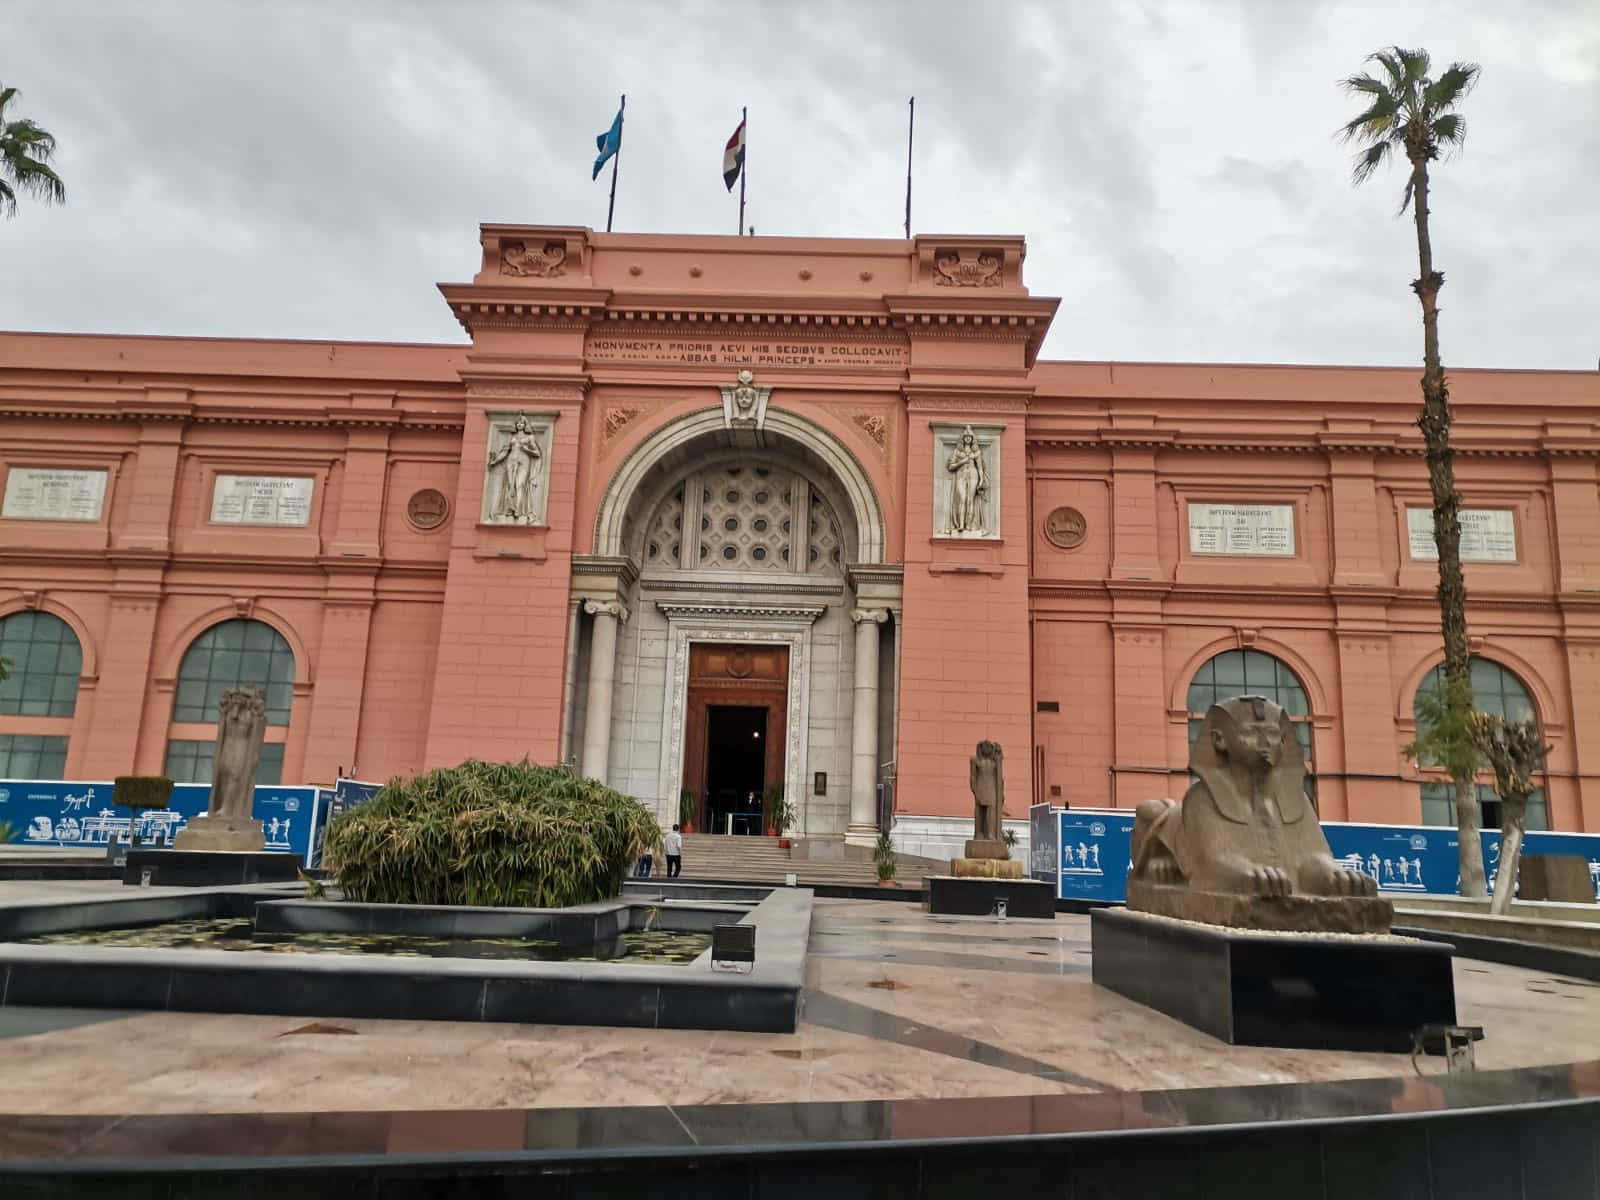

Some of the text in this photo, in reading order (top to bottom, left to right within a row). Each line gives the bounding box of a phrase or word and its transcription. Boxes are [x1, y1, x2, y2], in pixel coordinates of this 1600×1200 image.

[594, 341, 901, 356] MONVMENTA PRIORIS AEVI HIS SEDIBVS COLLOCAVIT
[680, 354, 717, 362] ABBAS
[723, 355, 752, 363] HILMI
[758, 355, 815, 364] PRINCEPS
